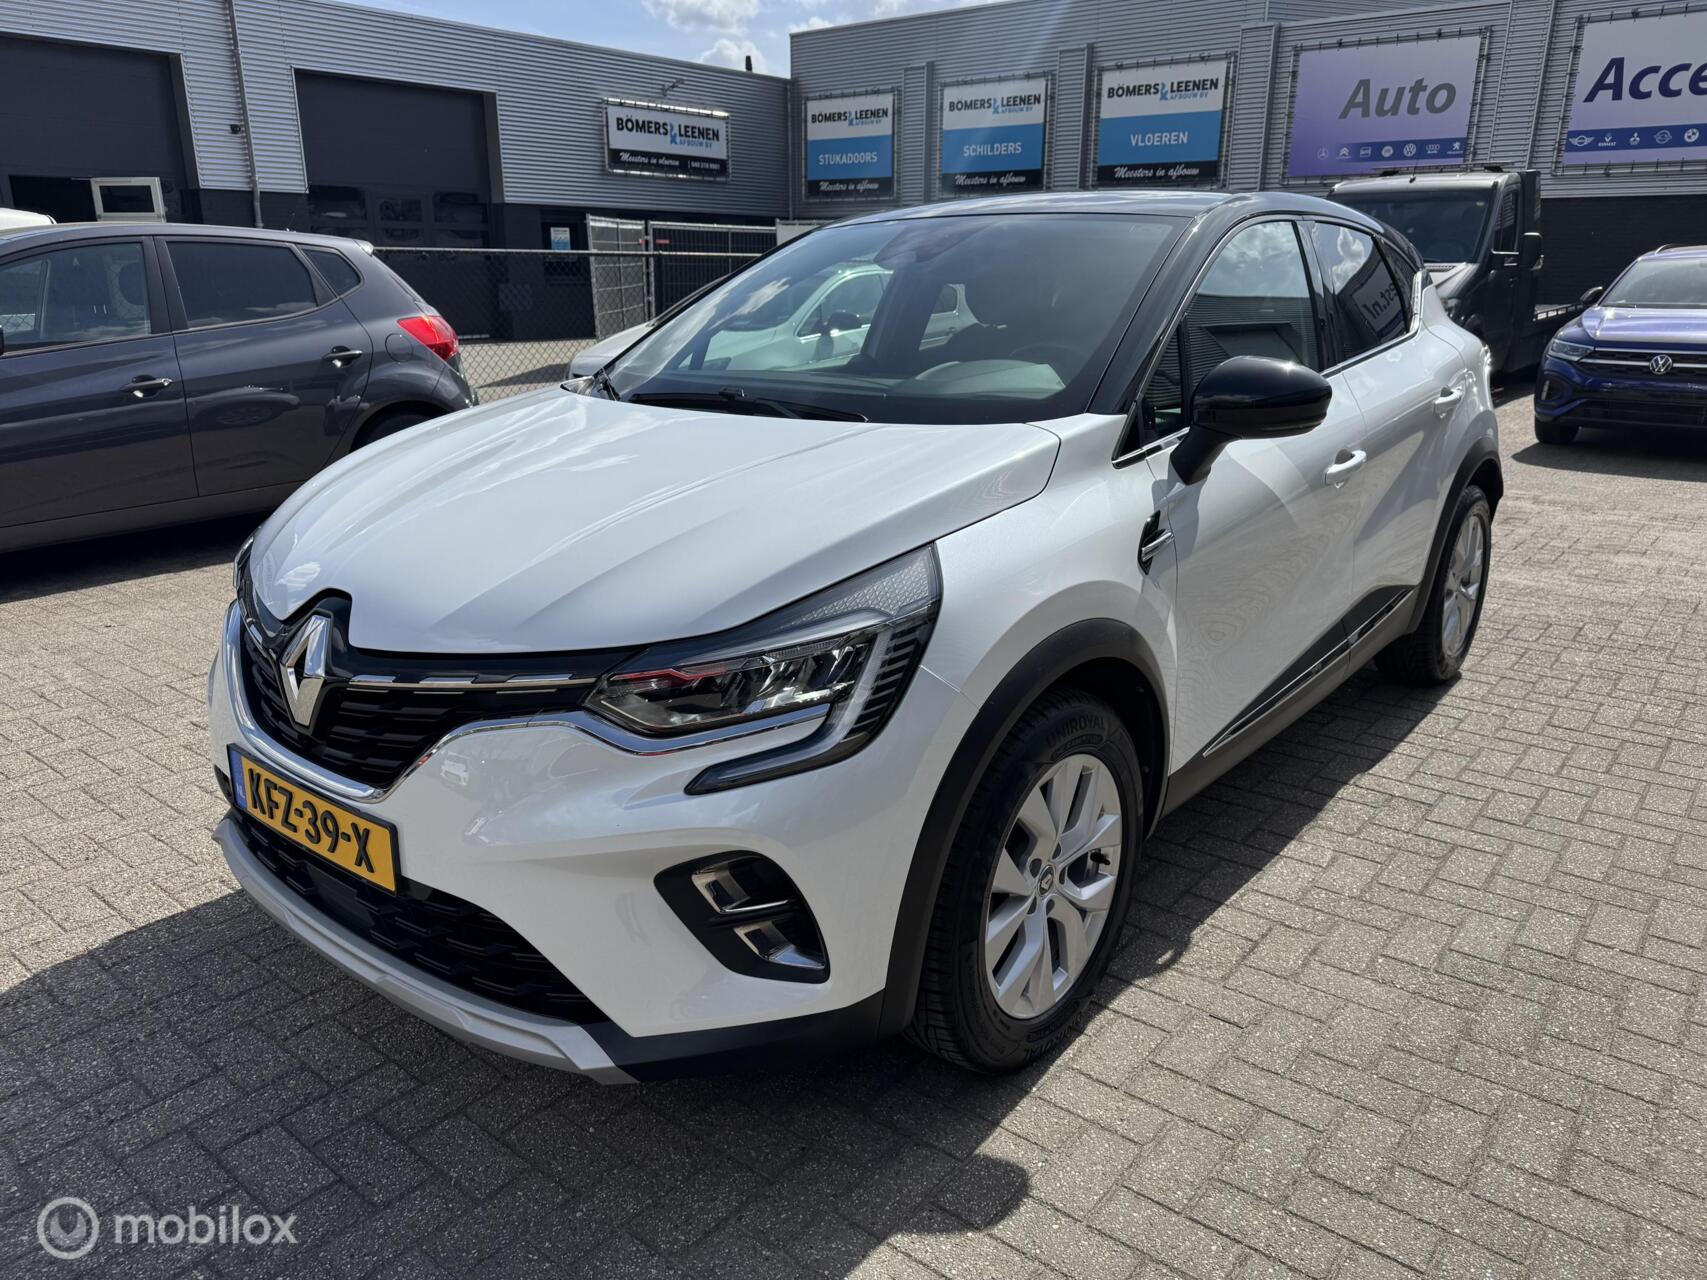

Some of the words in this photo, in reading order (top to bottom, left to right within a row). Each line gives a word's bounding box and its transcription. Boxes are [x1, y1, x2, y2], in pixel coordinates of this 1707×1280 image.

[1583, 56, 1707, 103] Acce
[1107, 81, 1160, 99] BÖMERS
[1169, 77, 1219, 94] LEENEN
[1001, 93, 1041, 108] LEENEN
[1169, 92, 1198, 101] AFBOUW
[1339, 78, 1456, 120] Auto
[855, 107, 889, 120] LEENEN
[616, 115, 669, 136] BÖMERS
[678, 123, 720, 142] LEENEN
[1130, 131, 1189, 147] VLOEREN
[963, 142, 1022, 157] SCHILDERS
[818, 151, 878, 166] STUKADOORS
[1113, 166, 1153, 179] Meesters
[1155, 167, 1165, 177] in
[1168, 164, 1200, 179] afbouw
[954, 174, 987, 186] Meesters
[989, 175, 997, 185] in
[999, 172, 1026, 187] afbouw
[1046, 714, 1106, 749] UNIROYAL
[247, 767, 375, 873] KFZ-39-X
